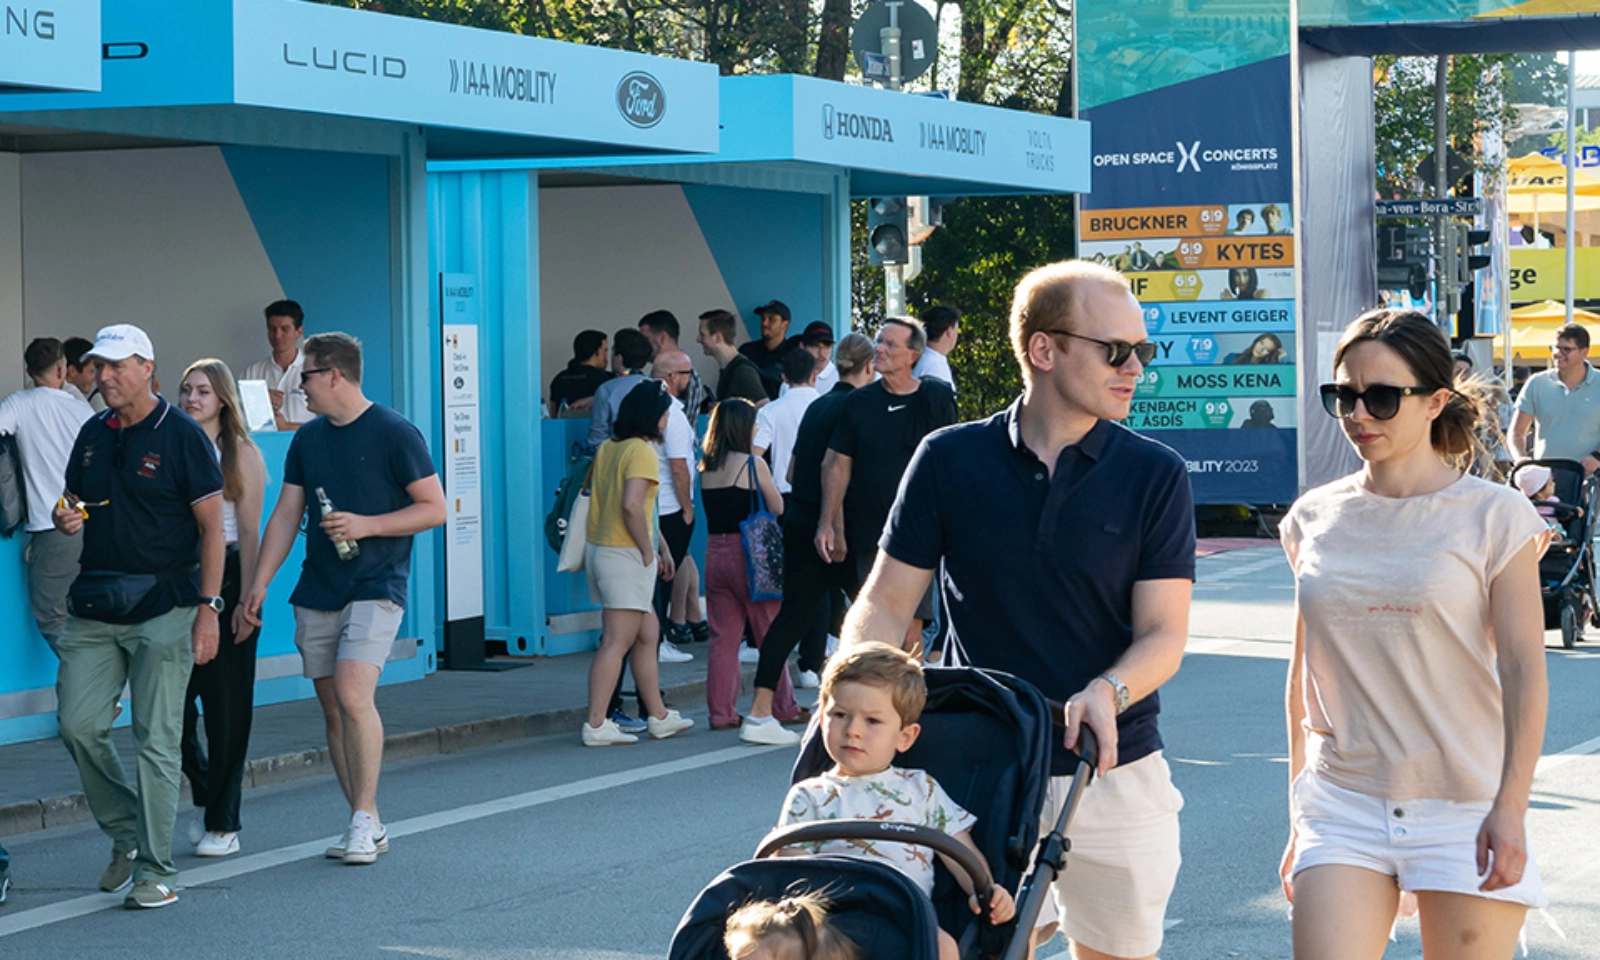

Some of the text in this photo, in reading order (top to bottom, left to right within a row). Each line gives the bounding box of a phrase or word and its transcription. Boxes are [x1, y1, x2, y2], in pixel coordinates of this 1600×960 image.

[283, 43, 406, 79] LUCID
[462, 60, 557, 104] IAA MOBILITY
[626, 79, 658, 118] Ford
[837, 112, 894, 143] HONDA
[928, 122, 987, 156] IAA MOBILITY
[1025, 151, 1055, 172] TRUCKS
[1093, 153, 1130, 167] OPEN
[1132, 151, 1175, 164] SPACE
[1202, 148, 1278, 162] CONCERTS
[1090, 214, 1187, 232] BRUCKNER
[1217, 243, 1284, 261] KYTES
[1171, 311, 1227, 324] LEVENT
[1232, 309, 1288, 323] GEIGER
[1177, 374, 1228, 389] MOSS
[1233, 373, 1282, 388] KENA
[1225, 460, 1259, 473] 2023
